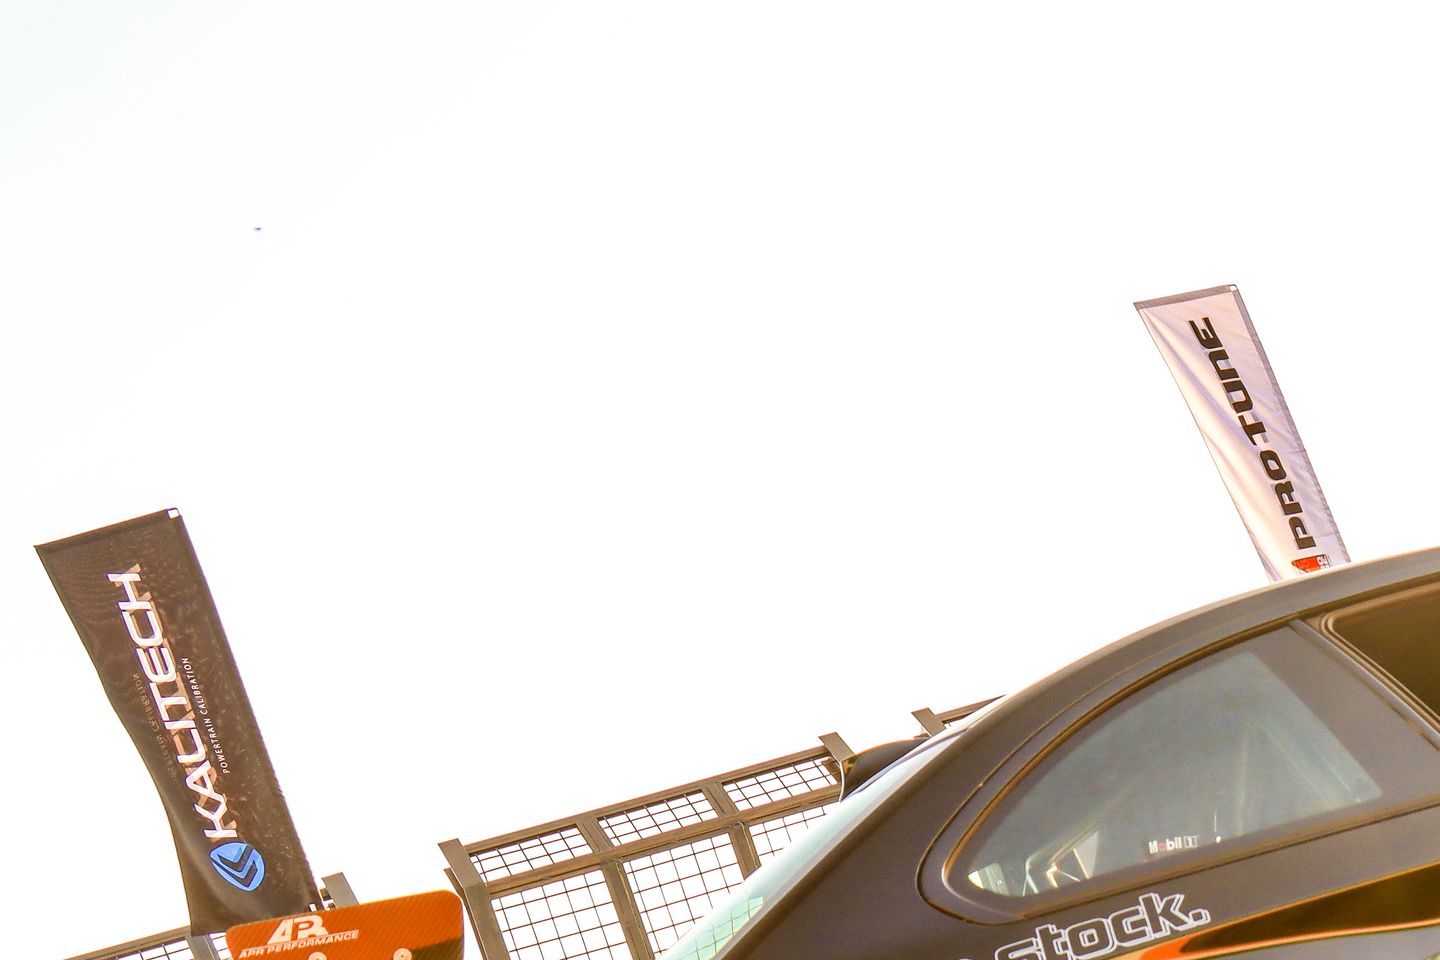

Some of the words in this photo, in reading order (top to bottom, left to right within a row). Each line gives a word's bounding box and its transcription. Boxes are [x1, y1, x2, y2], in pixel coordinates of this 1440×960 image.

[1188, 316, 1267, 446] TUNE
[1260, 449, 1317, 550] PRO
[108, 565, 238, 839] KALITECH
[181, 657, 208, 715] CALIBRATION
[203, 718, 230, 774] POWERTRAIN
[1148, 836, 1182, 854] Mobil
[238, 948, 264, 960] APR
[266, 931, 359, 955] PERFORMANCE
